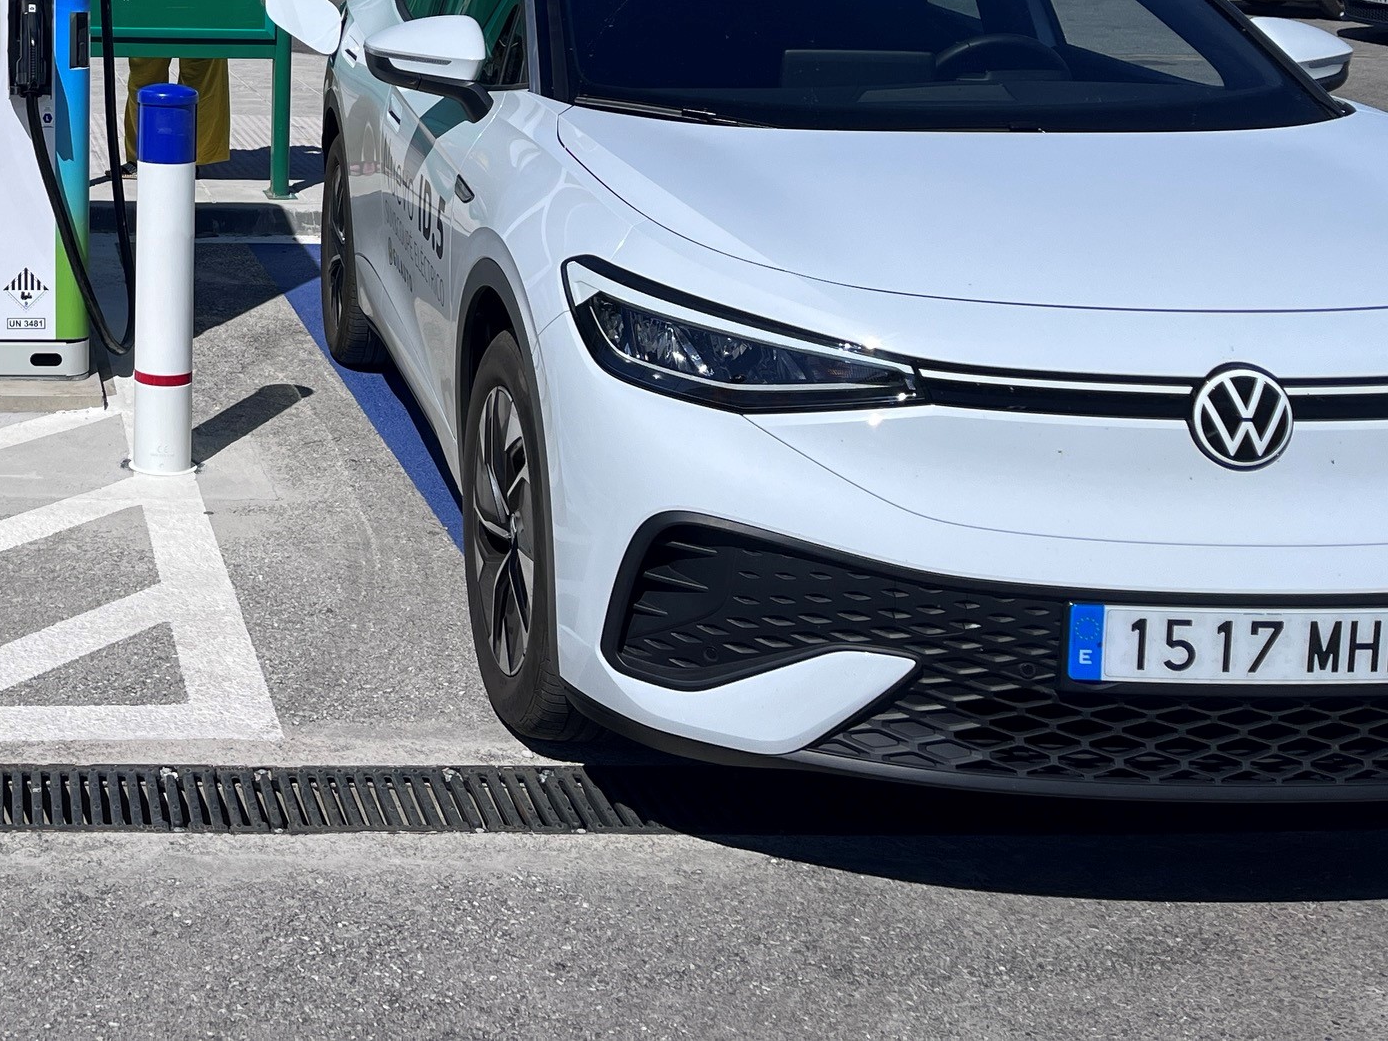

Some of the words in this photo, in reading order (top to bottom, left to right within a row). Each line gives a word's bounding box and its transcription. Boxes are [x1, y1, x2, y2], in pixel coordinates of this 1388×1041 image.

[418, 173, 446, 260] ID.5
[9, 320, 22, 328] UN
[23, 320, 43, 328] 3481
[1078, 649, 1093, 665] E
[1131, 618, 1285, 674] 1517
[1306, 619, 1388, 674] MH
